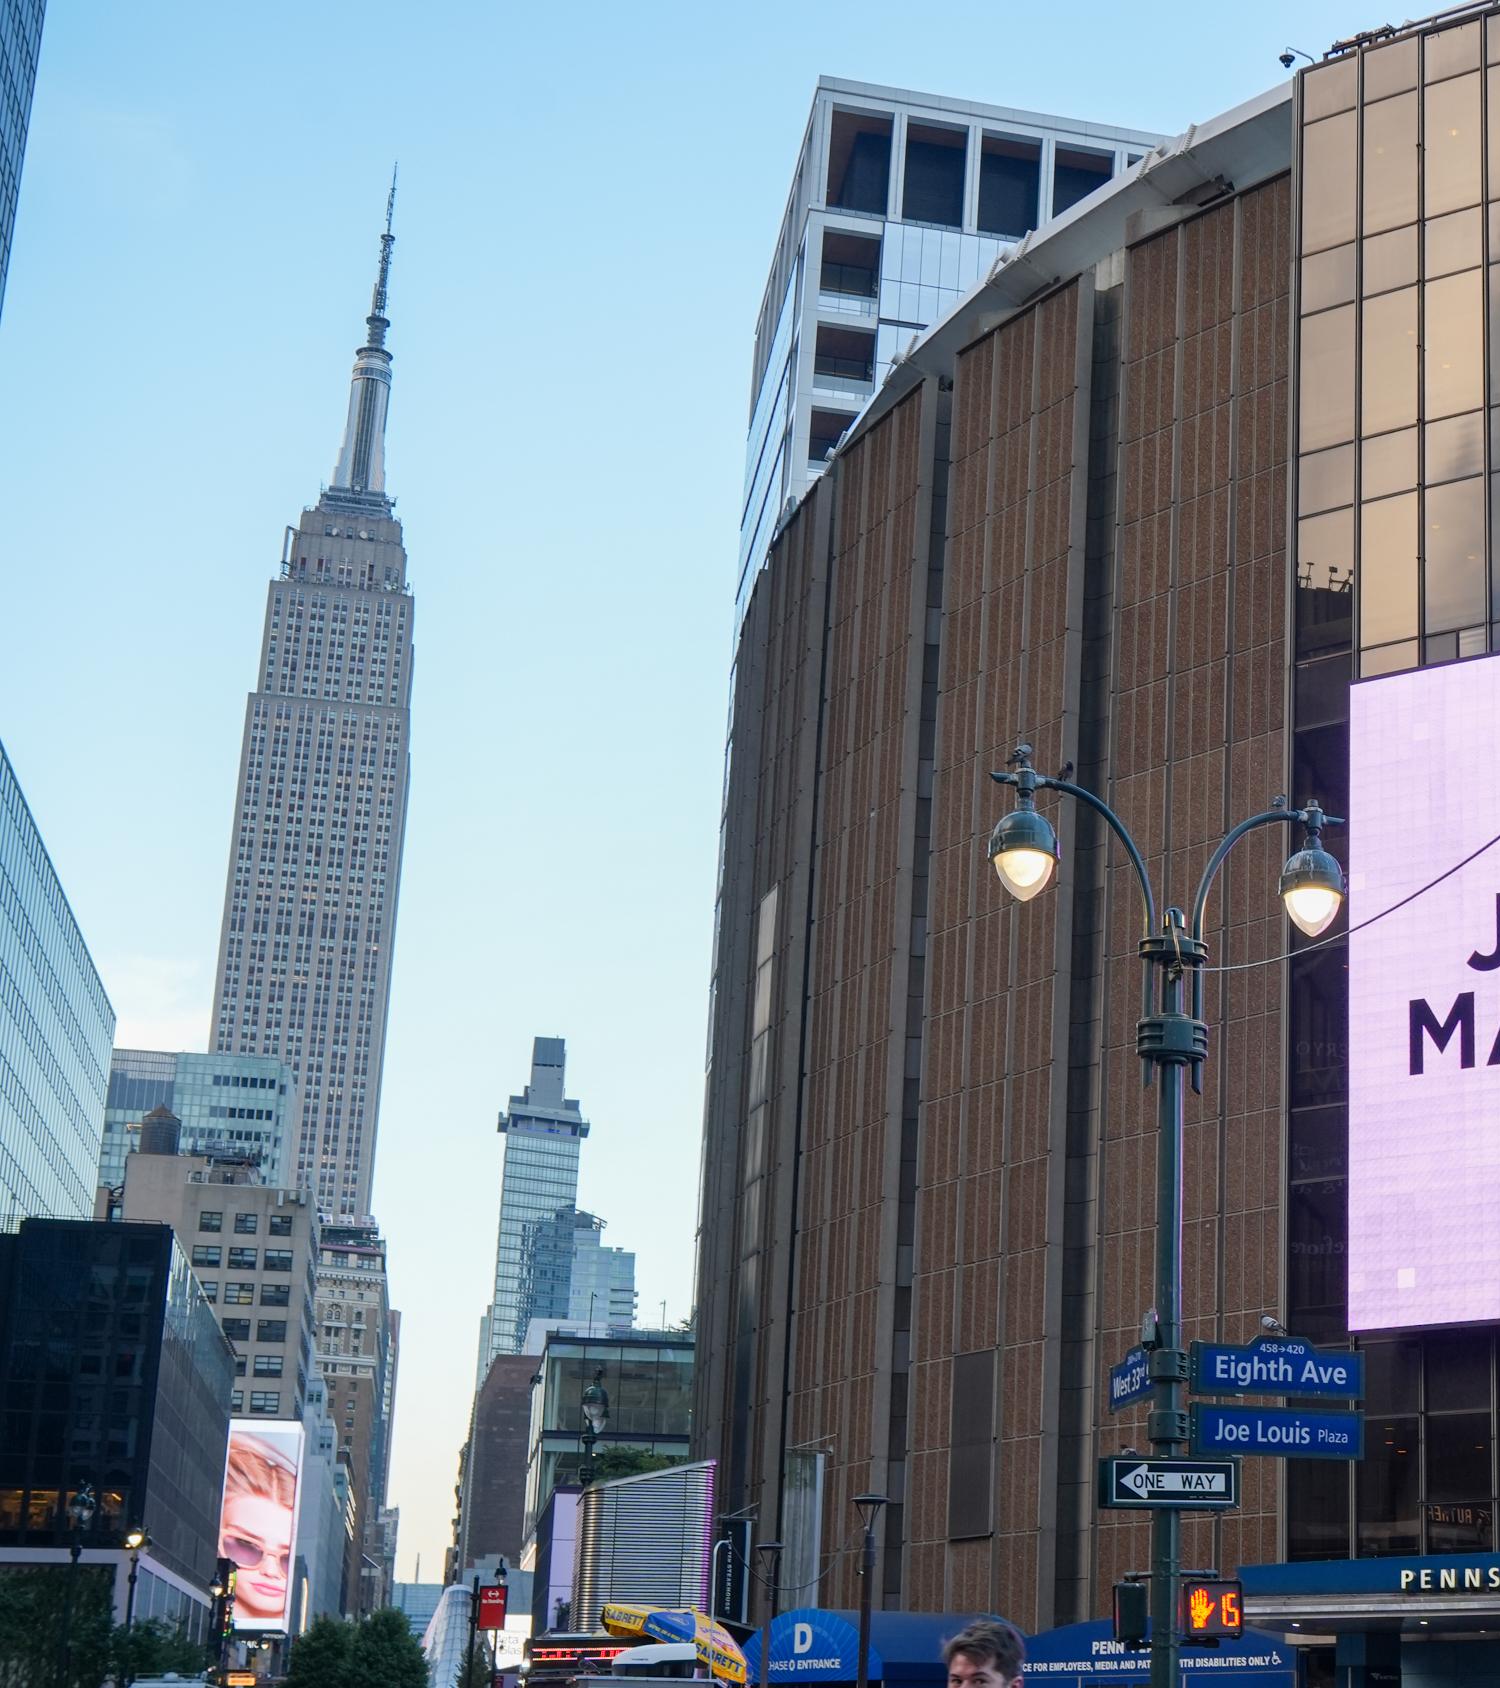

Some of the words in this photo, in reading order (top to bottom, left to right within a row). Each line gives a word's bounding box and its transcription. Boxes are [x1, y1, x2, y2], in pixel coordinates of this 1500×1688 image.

[1216, 1355, 1292, 1386] Eighth
[1300, 1360, 1347, 1385] Ave
[1113, 1372, 1131, 1399] West
[1214, 1418, 1250, 1442] Joe
[1257, 1420, 1311, 1444] Louis
[1318, 1429, 1349, 1444] Plaza
[1133, 1473, 1165, 1489] ONE
[1181, 1474, 1216, 1489] WAY
[605, 1608, 644, 1626] SABRETT
[794, 1623, 813, 1654] D
[1092, 1641, 1125, 1655] PENN
[768, 1661, 788, 1671] HASE
[797, 1659, 841, 1670] ENTRANCE
[1033, 1663, 1048, 1672] FOR
[1049, 1661, 1094, 1673] EMPLOYEES,
[1095, 1661, 1119, 1670] MEDIA
[1120, 1660, 1136, 1670] AND
[1195, 1657, 1247, 1667] DISABILITIES
[1248, 1656, 1270, 1666] ONLY
